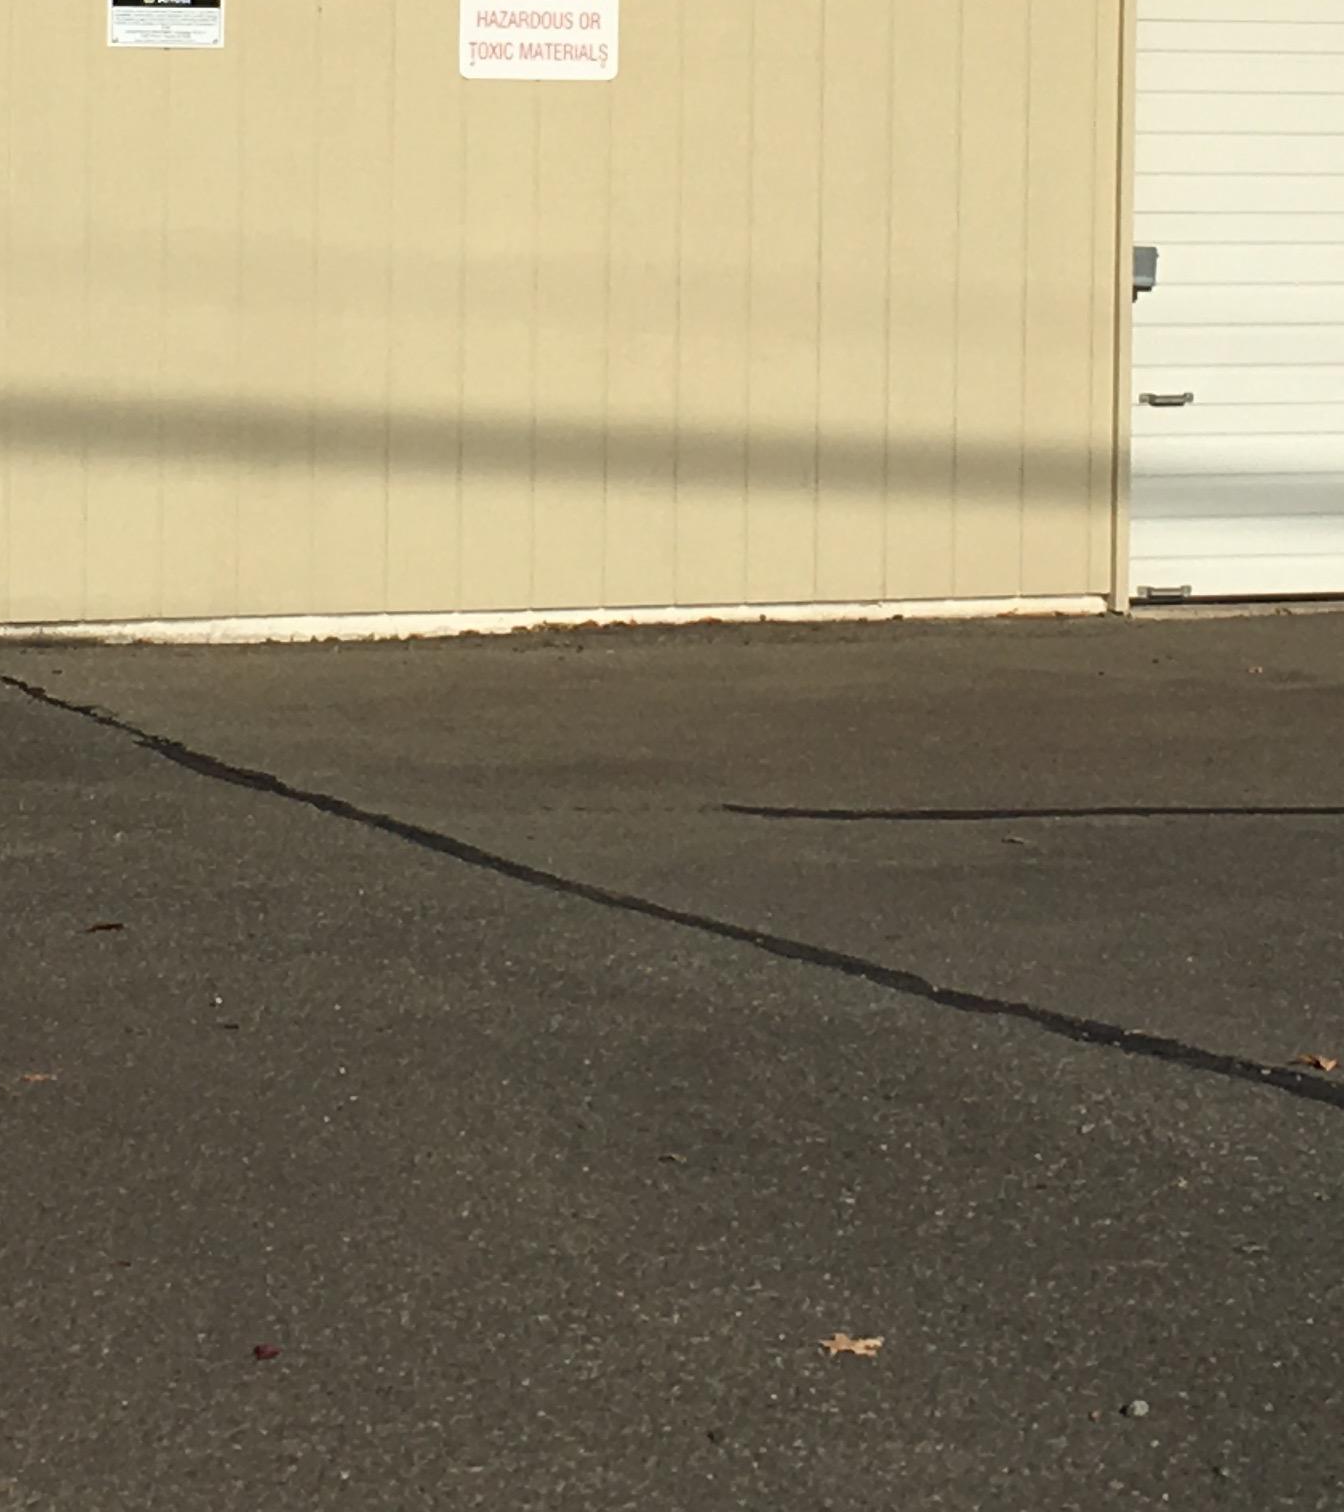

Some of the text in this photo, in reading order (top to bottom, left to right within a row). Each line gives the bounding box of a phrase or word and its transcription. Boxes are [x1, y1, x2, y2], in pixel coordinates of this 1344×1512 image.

[476, 10, 601, 30] HAZARDOUS OR
[468, 42, 609, 62] TOXIC MATERIALS
